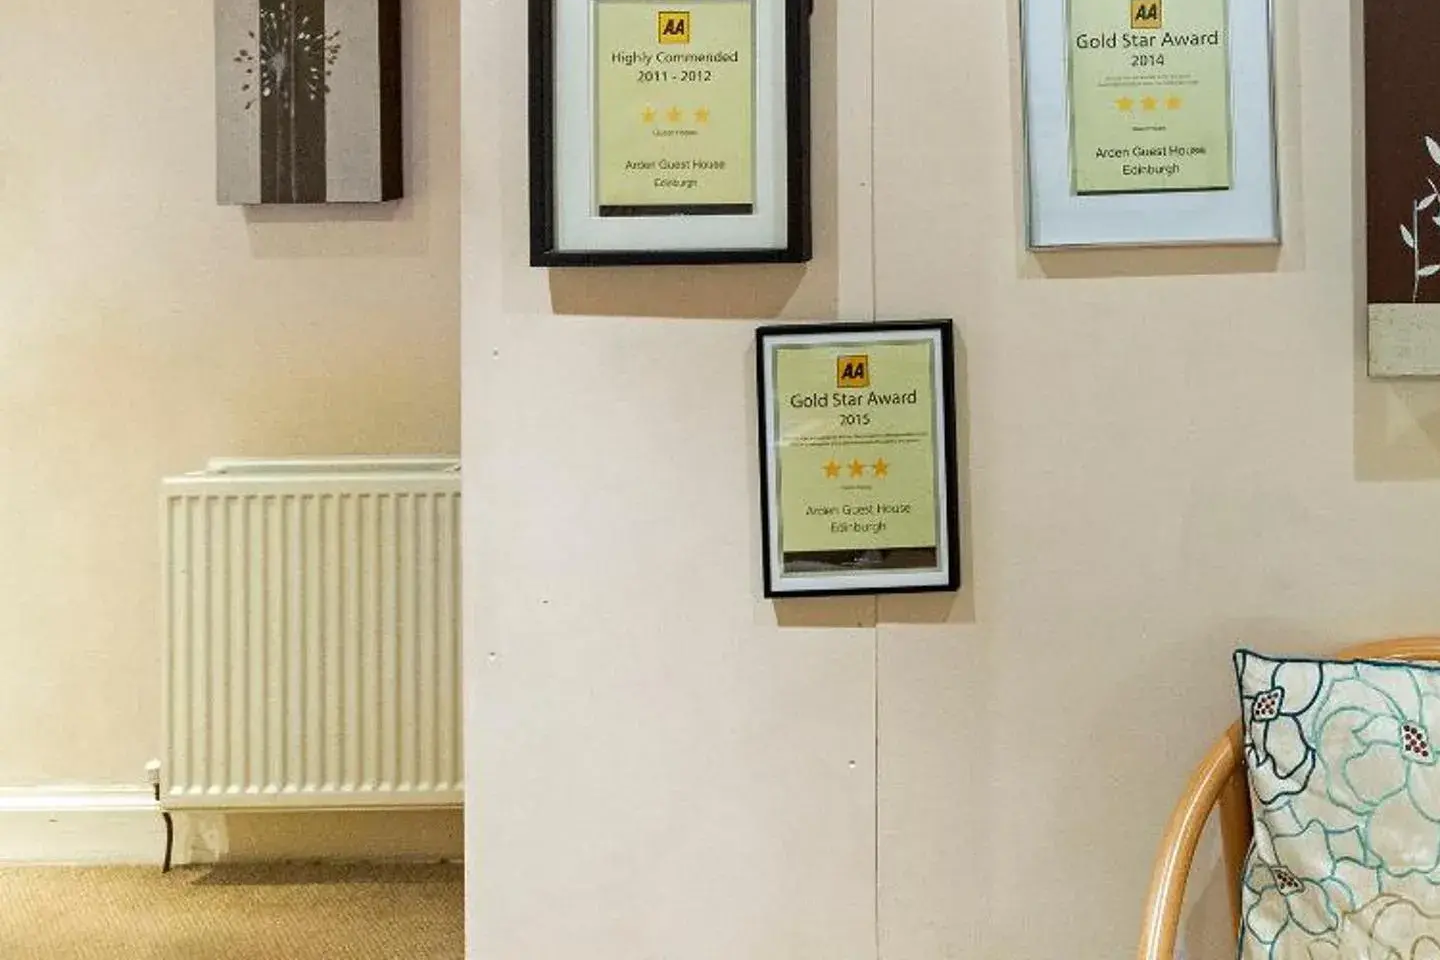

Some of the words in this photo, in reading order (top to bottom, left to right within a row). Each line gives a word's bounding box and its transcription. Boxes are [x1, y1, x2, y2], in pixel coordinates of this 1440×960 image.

[1135, 4, 1158, 20] AA
[663, 19, 685, 35] AA
[1076, 33, 1116, 49] Gold
[1122, 33, 1156, 48] Star
[1161, 30, 1218, 46] Award
[612, 51, 651, 66] Highly
[656, 51, 738, 63] Commended
[1131, 54, 1165, 67] 2014
[637, 71, 668, 82] 2011
[681, 71, 712, 82] 2012
[1096, 147, 1129, 159] Arden
[1132, 146, 1167, 157] Guest
[1122, 164, 1179, 176] Edinburgh
[841, 362, 864, 379] AA
[790, 393, 828, 408] Gold
[833, 392, 863, 407] Star
[867, 390, 917, 406] Award
[839, 414, 871, 426] 2015
